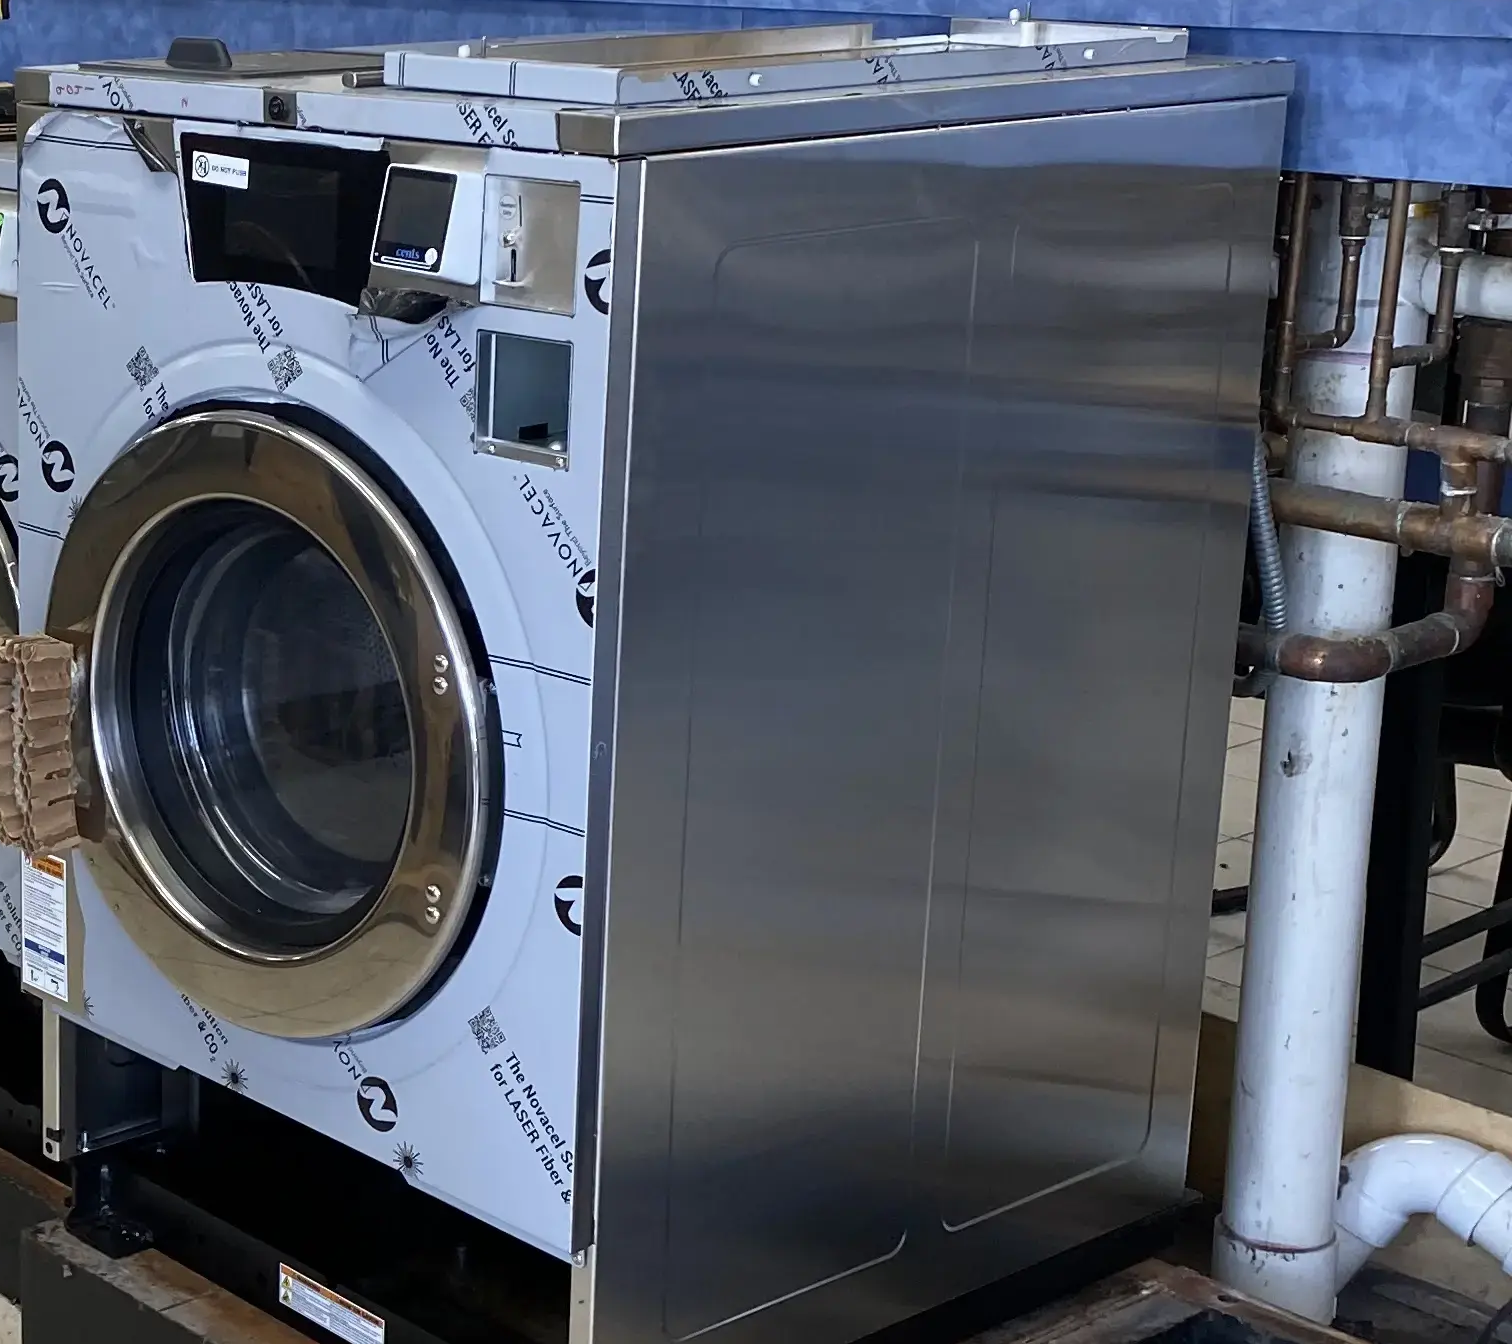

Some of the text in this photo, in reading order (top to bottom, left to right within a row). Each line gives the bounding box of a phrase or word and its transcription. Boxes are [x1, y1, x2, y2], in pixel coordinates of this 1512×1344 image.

[220, 166, 231, 174] NOT
[66, 223, 110, 310] NOVACEL
[395, 247, 420, 259] cents
[254, 324, 271, 354] The
[268, 315, 283, 338] for
[440, 357, 460, 389] The
[458, 349, 477, 374] for
[143, 397, 155, 419] for
[155, 382, 169, 411] The
[520, 474, 583, 578] NOVACEL
[543, 489, 592, 567] Beyond The Surface
[197, 1021, 206, 1032] &
[506, 1051, 566, 1149] The Novacel
[490, 1063, 508, 1087] for
[504, 1088, 540, 1144] LASER
[535, 1144, 564, 1186] Fiber
